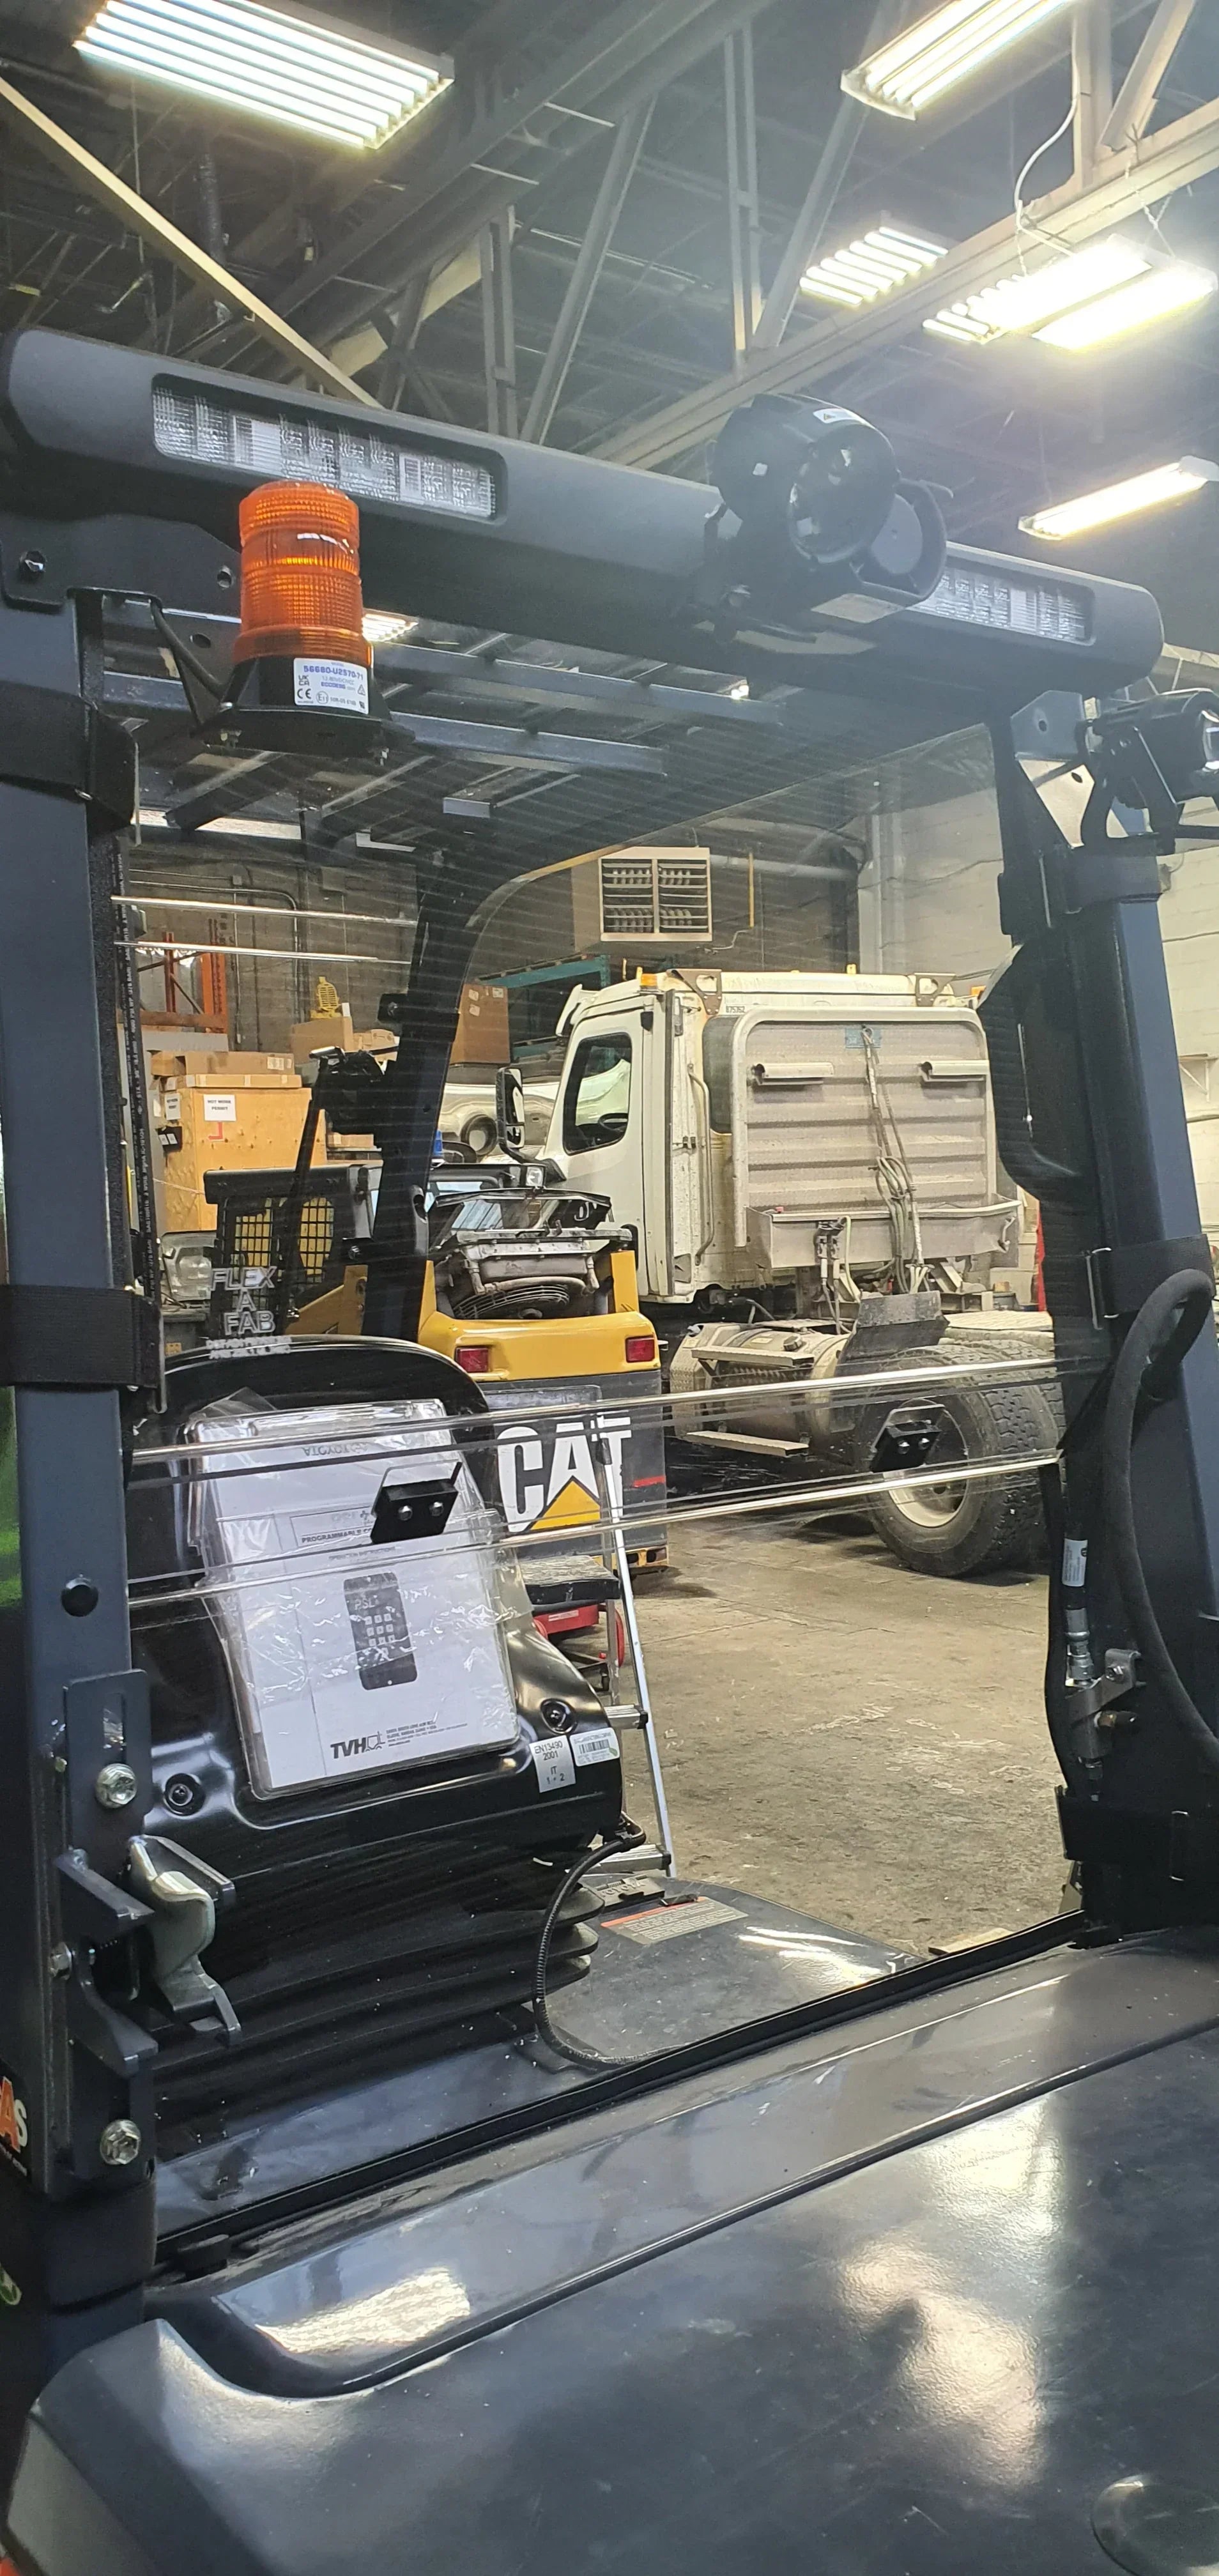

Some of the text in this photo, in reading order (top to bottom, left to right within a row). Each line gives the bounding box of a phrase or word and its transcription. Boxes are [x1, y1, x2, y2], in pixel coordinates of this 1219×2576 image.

[303, 665, 364, 680] 56680-U2570-71
[297, 688, 312, 699] CE
[210, 1266, 277, 1291] FLEX
[236, 1287, 257, 1312] A
[224, 1310, 276, 1335] FAB
[496, 1416, 632, 1532] CAT
[330, 1737, 367, 1759] TVH
[534, 1740, 564, 1754] EN13490
[543, 1751, 559, 1761] 2001
[550, 1765, 557, 1775] IT
[559, 1773, 565, 1782] 2
